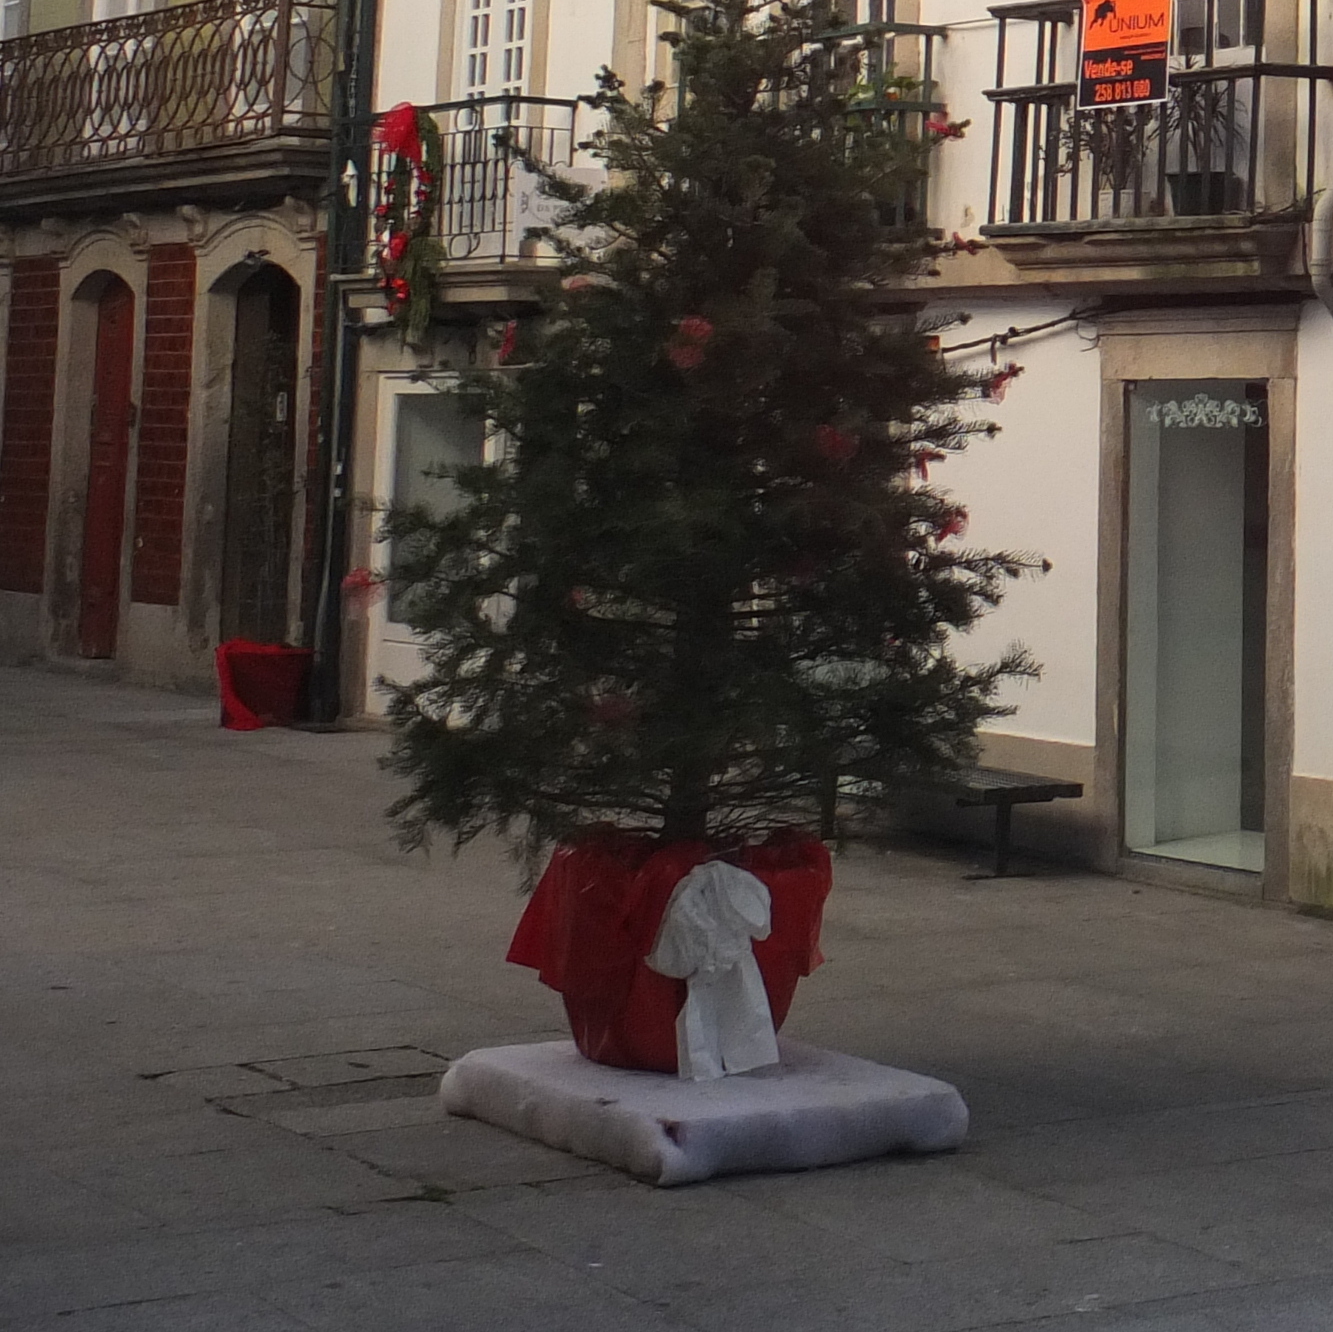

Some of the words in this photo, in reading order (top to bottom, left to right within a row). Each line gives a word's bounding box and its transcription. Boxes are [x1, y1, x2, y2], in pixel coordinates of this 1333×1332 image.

[1109, 12, 1165, 33] UNIUM
[1084, 58, 1134, 79] Vende-se
[1094, 83, 1113, 102] 258
[1115, 80, 1132, 100] 813
